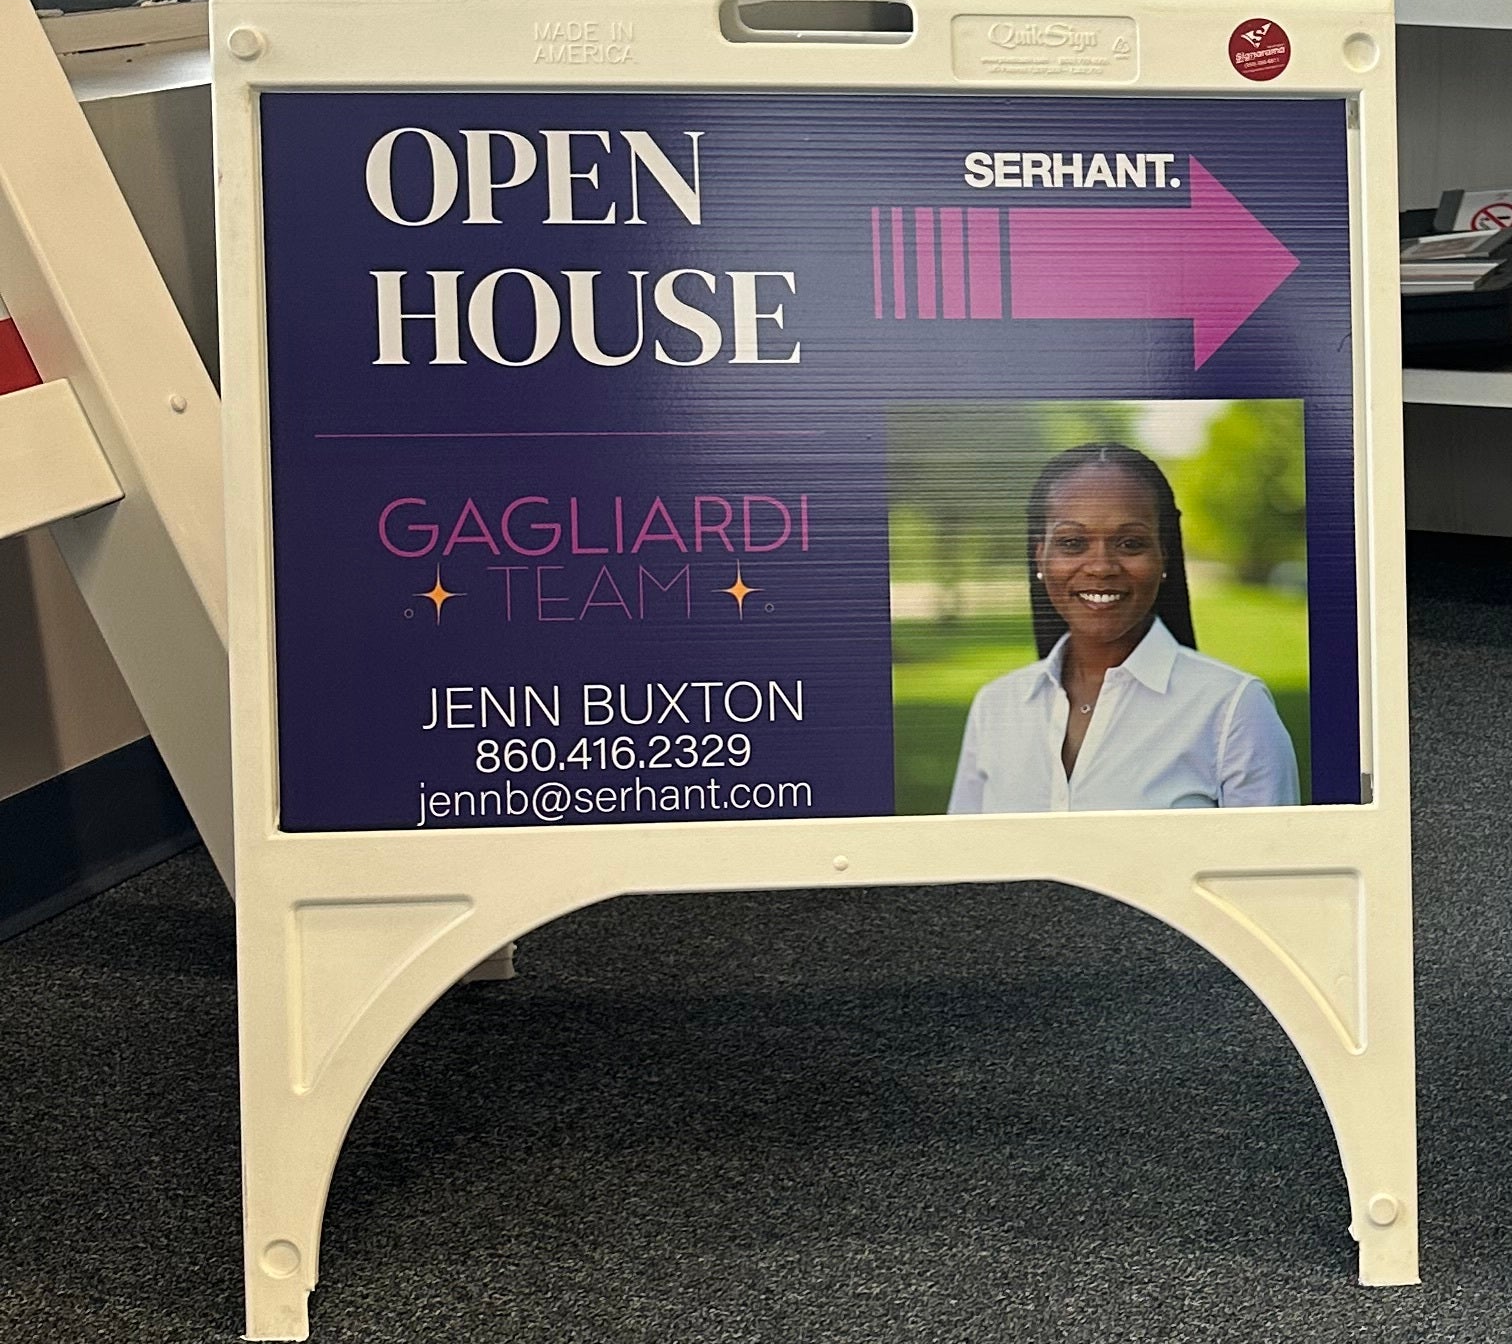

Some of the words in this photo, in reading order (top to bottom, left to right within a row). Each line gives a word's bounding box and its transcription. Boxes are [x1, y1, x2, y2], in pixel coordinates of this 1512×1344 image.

[533, 44, 636, 65] AMERICA
[534, 22, 598, 43] MADE
[611, 22, 634, 43] IN
[987, 22, 1098, 52] QuikSign
[365, 127, 705, 227] OPEN
[964, 151, 1181, 188] SERHANT.
[369, 267, 801, 368] HOUSE
[378, 496, 809, 558] GAGLIARDI
[487, 563, 691, 623] TEAM
[422, 684, 560, 730] JENN
[584, 680, 804, 726] BUXTON
[475, 733, 752, 774] 860.416.2329
[416, 776, 813, 827] jennb@serhant.com
